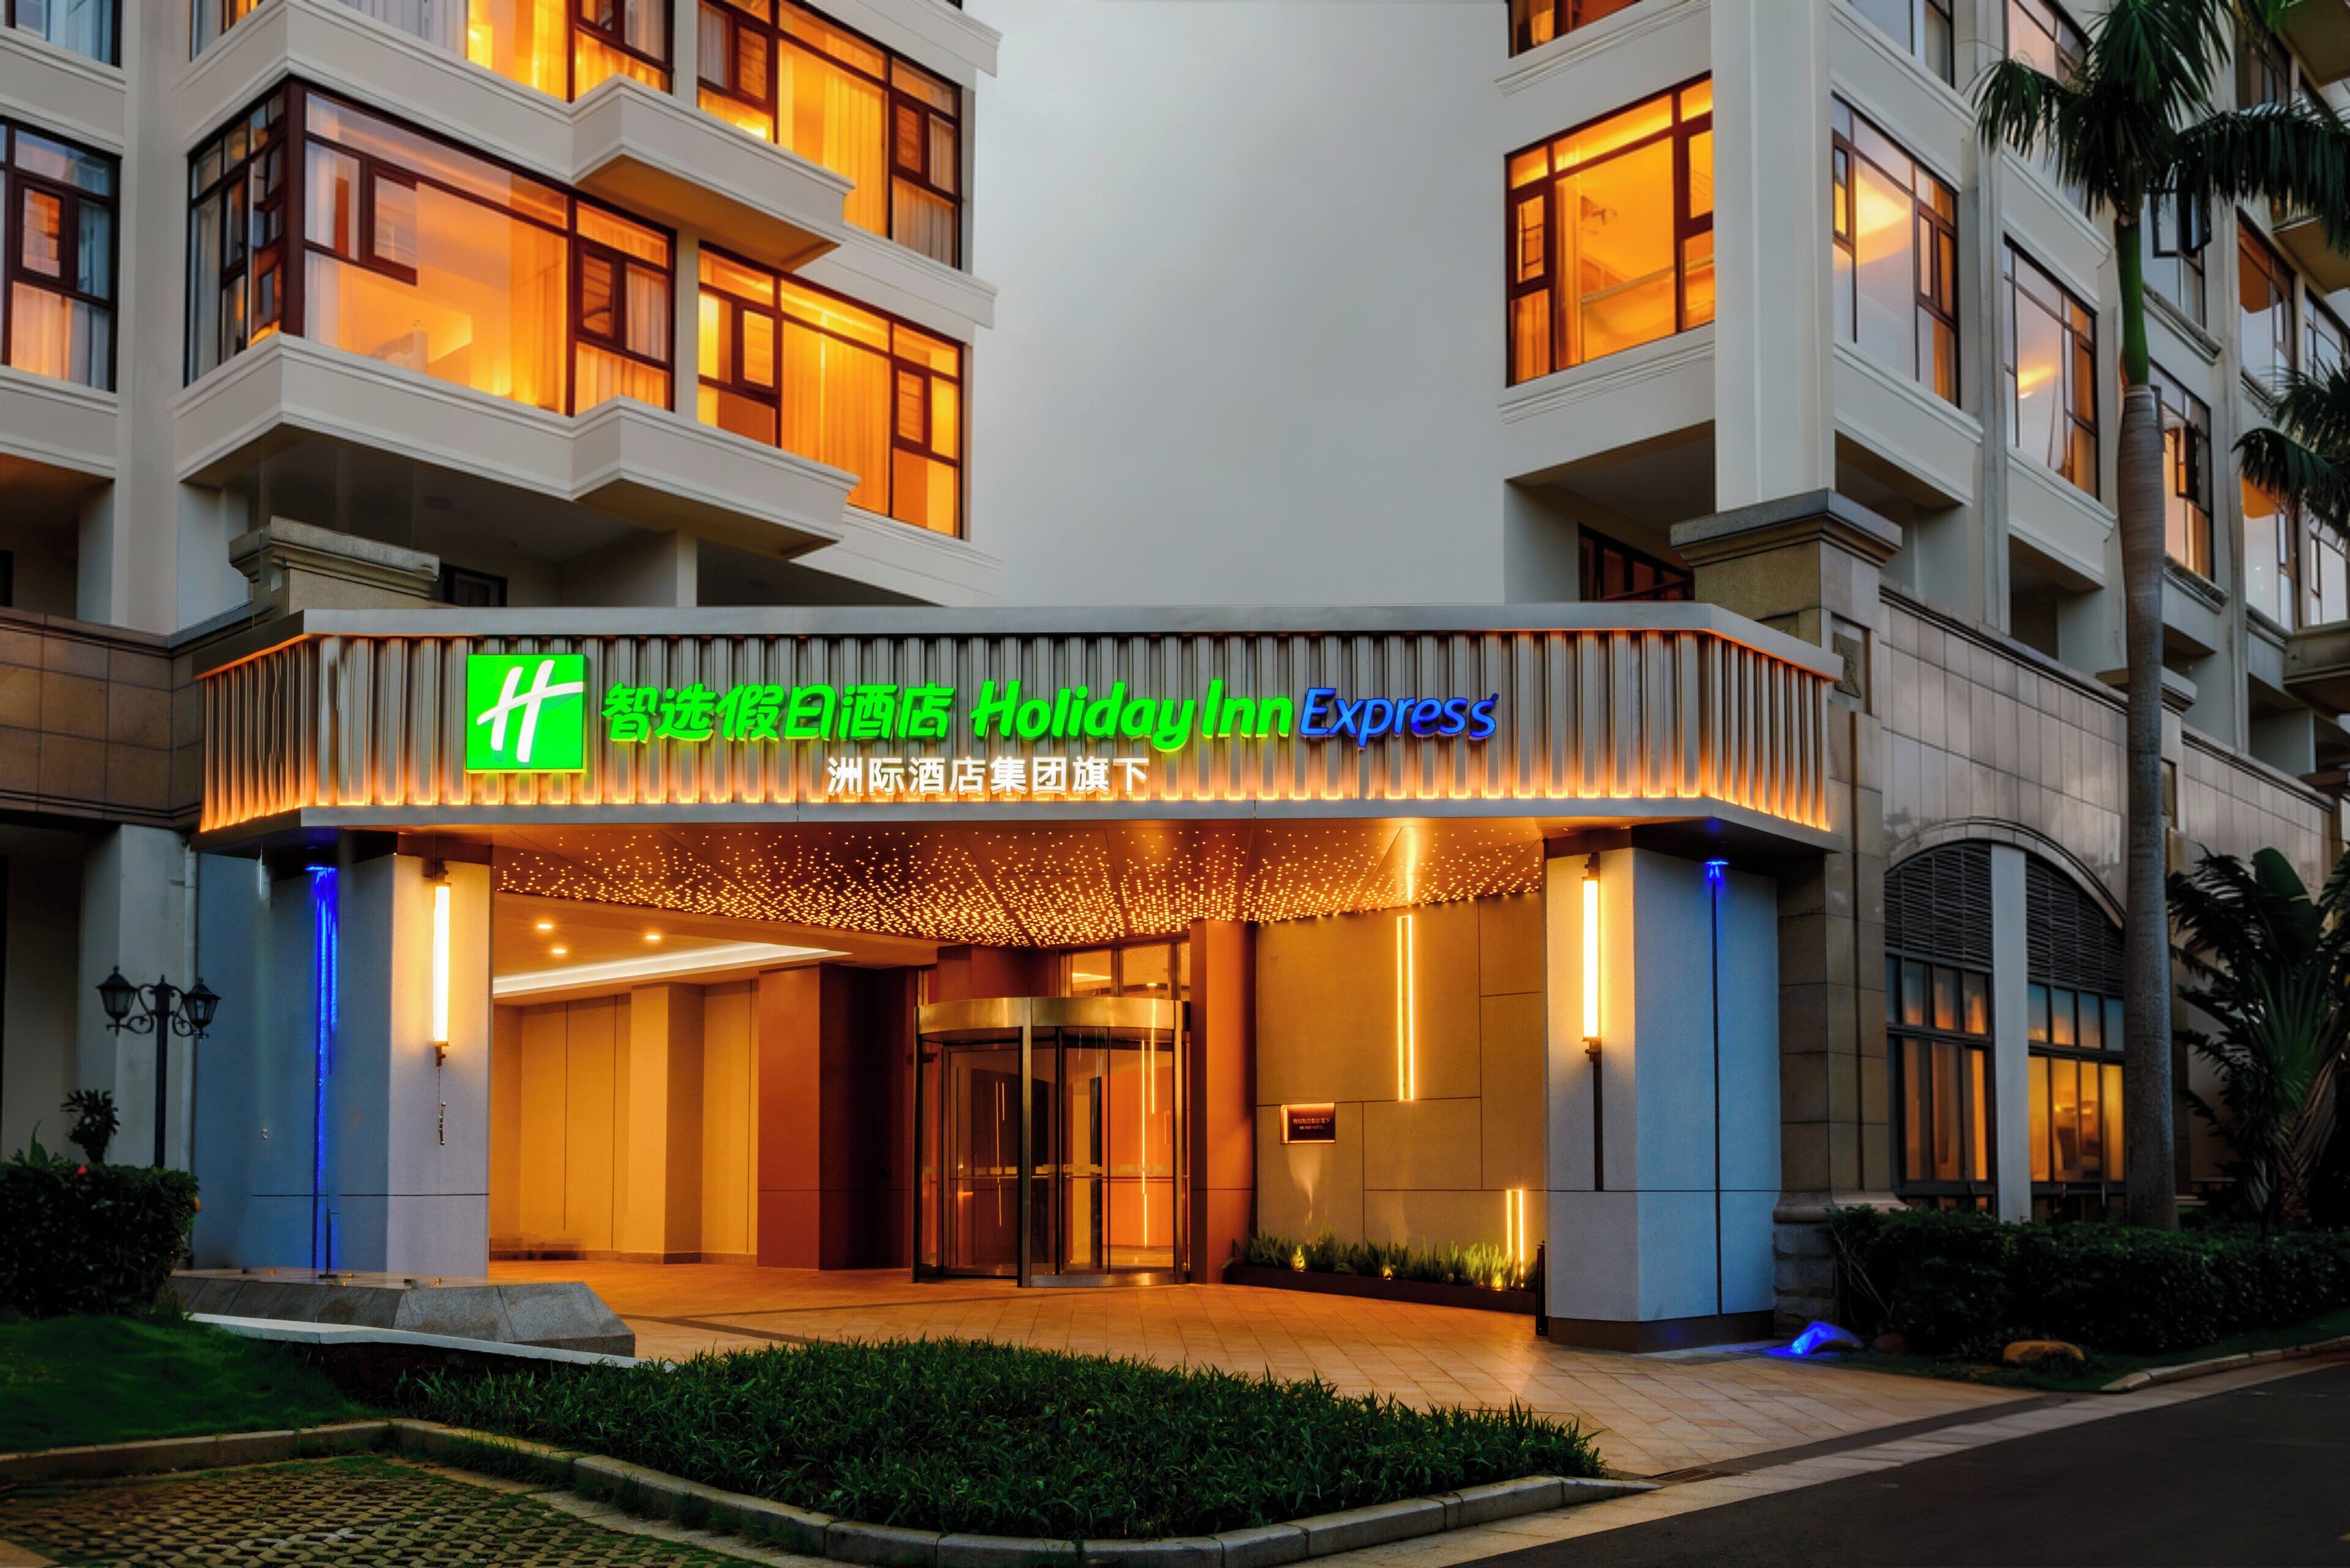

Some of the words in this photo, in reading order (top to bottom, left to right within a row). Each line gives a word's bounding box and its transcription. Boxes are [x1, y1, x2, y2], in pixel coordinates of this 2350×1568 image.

[602, 682, 955, 742] 智选假日酒店
[971, 679, 1195, 752] Holiday
[1201, 679, 1293, 738] Inn
[1300, 687, 1499, 749] Express
[827, 756, 1150, 796] 洲际酒店集团旗下
